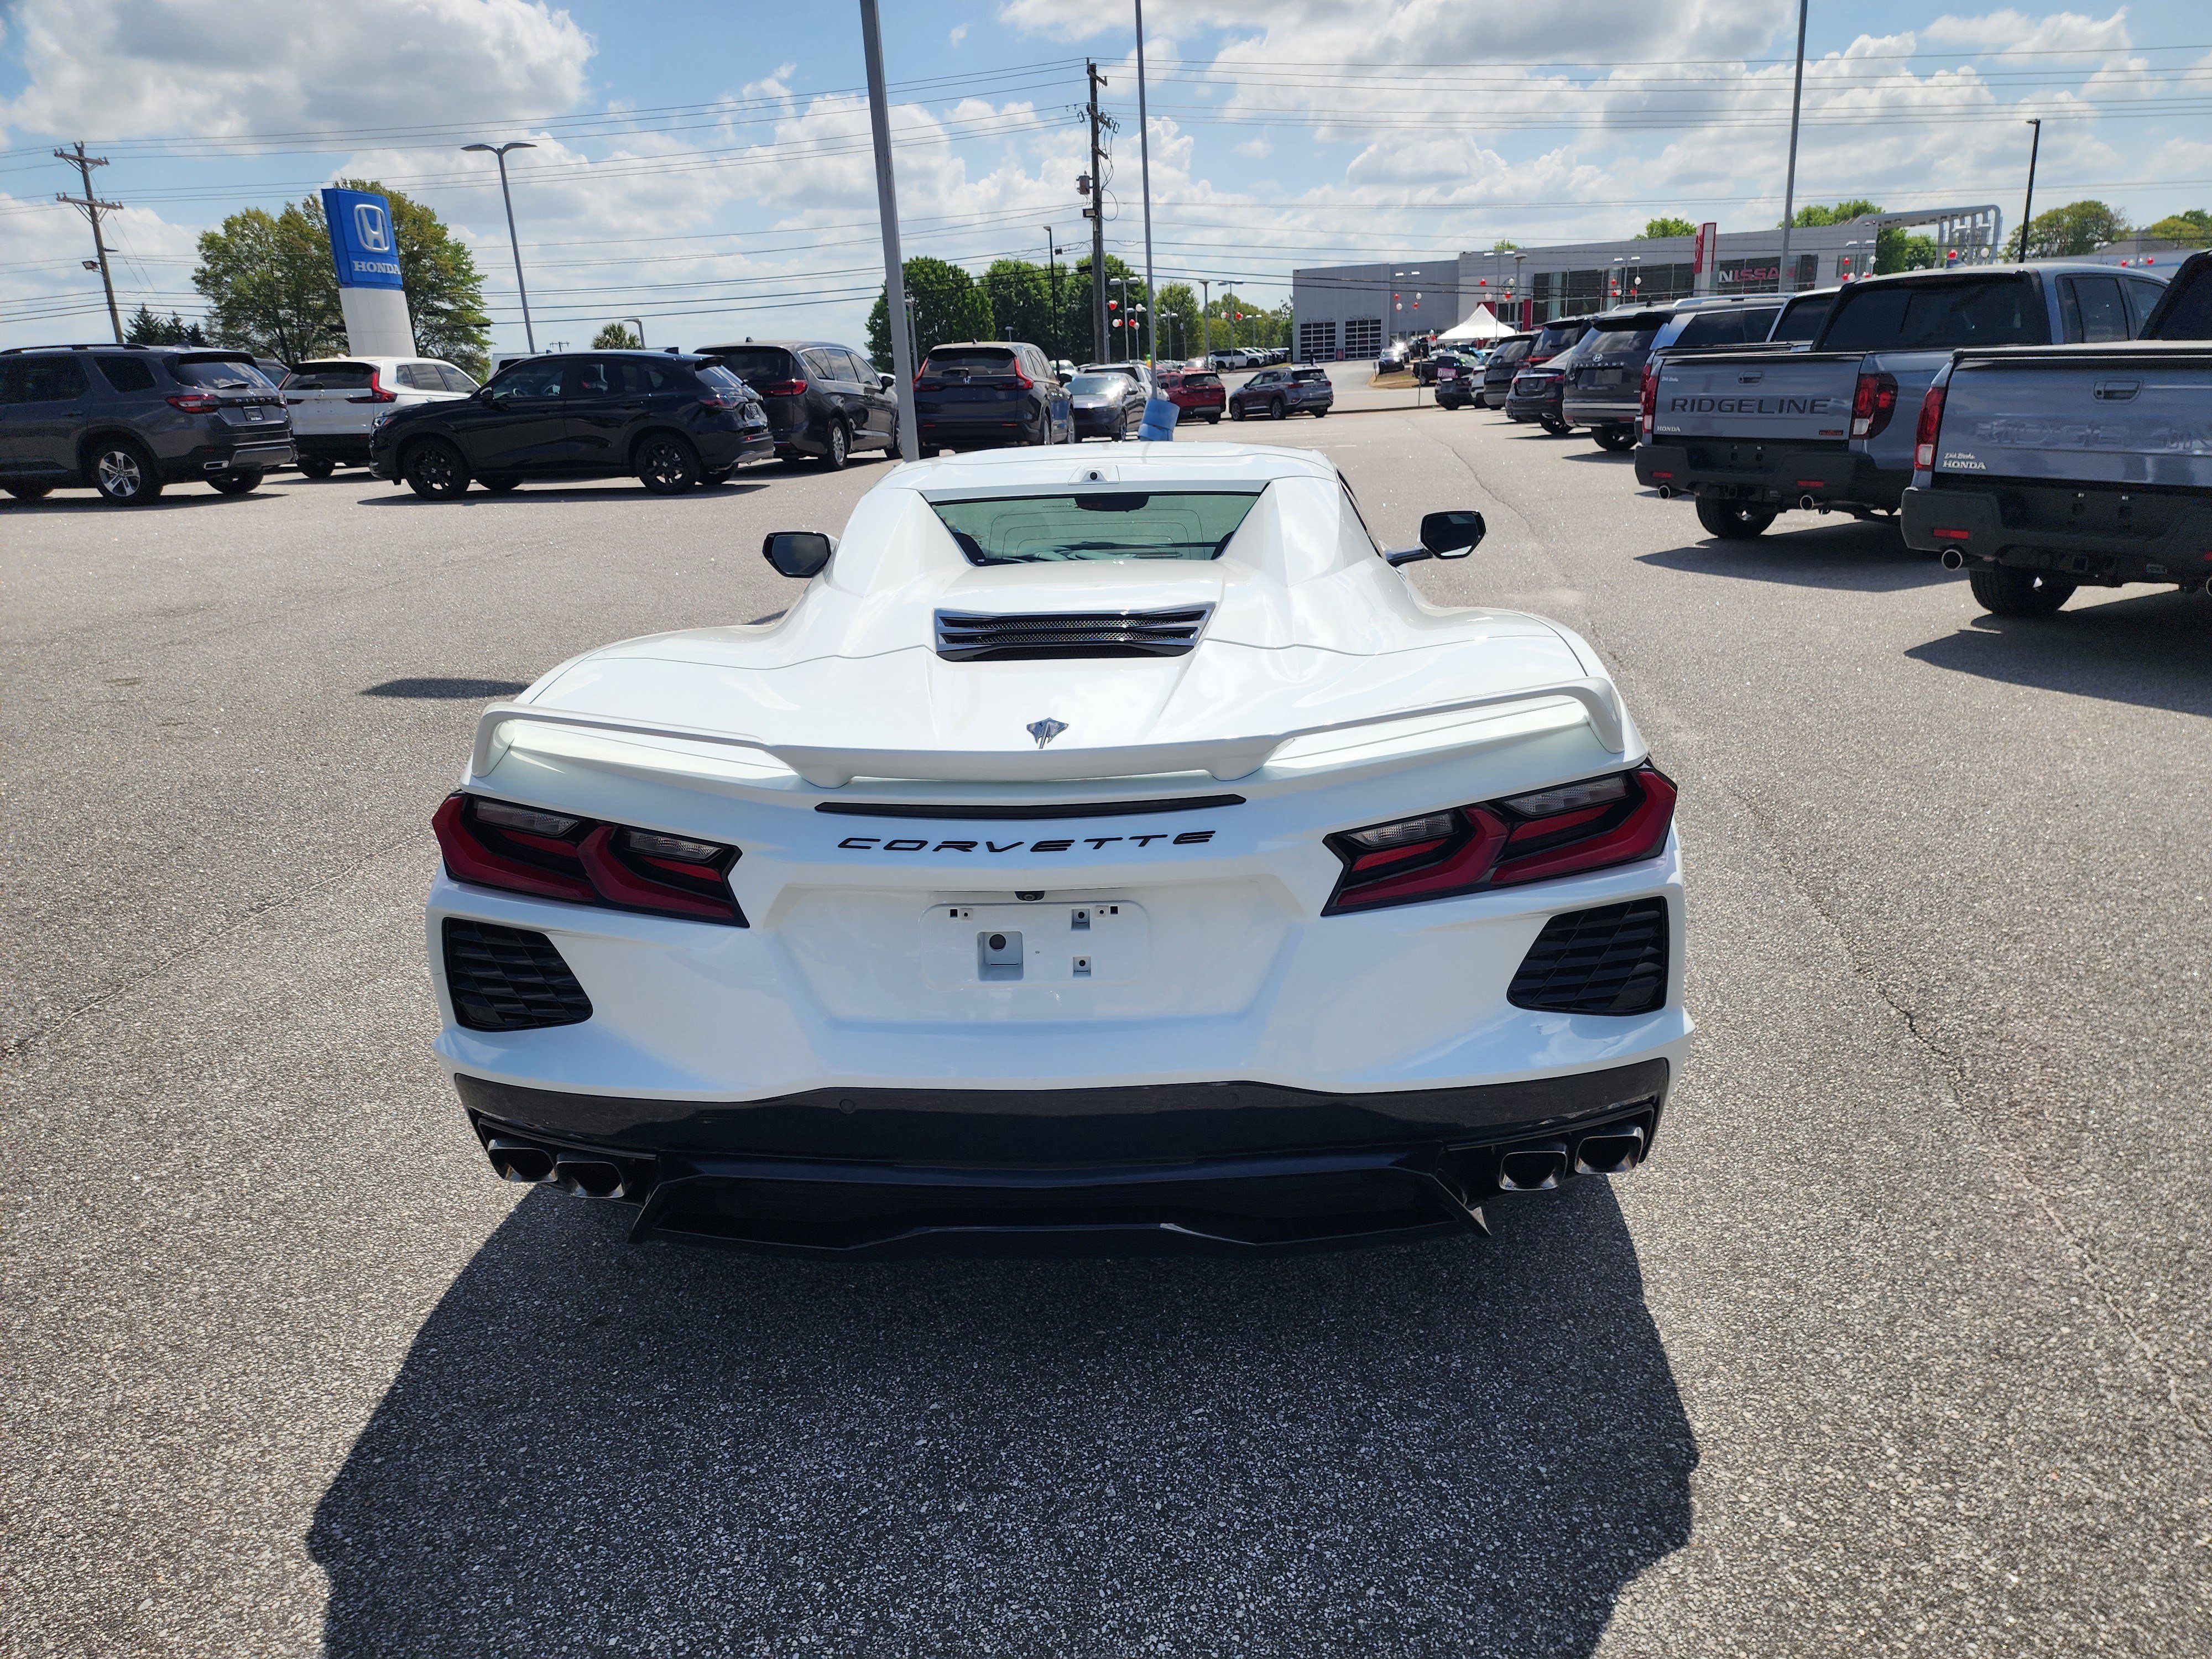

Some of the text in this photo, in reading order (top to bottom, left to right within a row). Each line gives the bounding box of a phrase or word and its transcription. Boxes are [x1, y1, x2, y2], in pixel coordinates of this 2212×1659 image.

[353, 260, 401, 275] HONDA
[1671, 398, 1830, 415] RIDGELINE
[1943, 460, 1986, 469] HONDA
[837, 830, 1217, 853] CORVETTE
